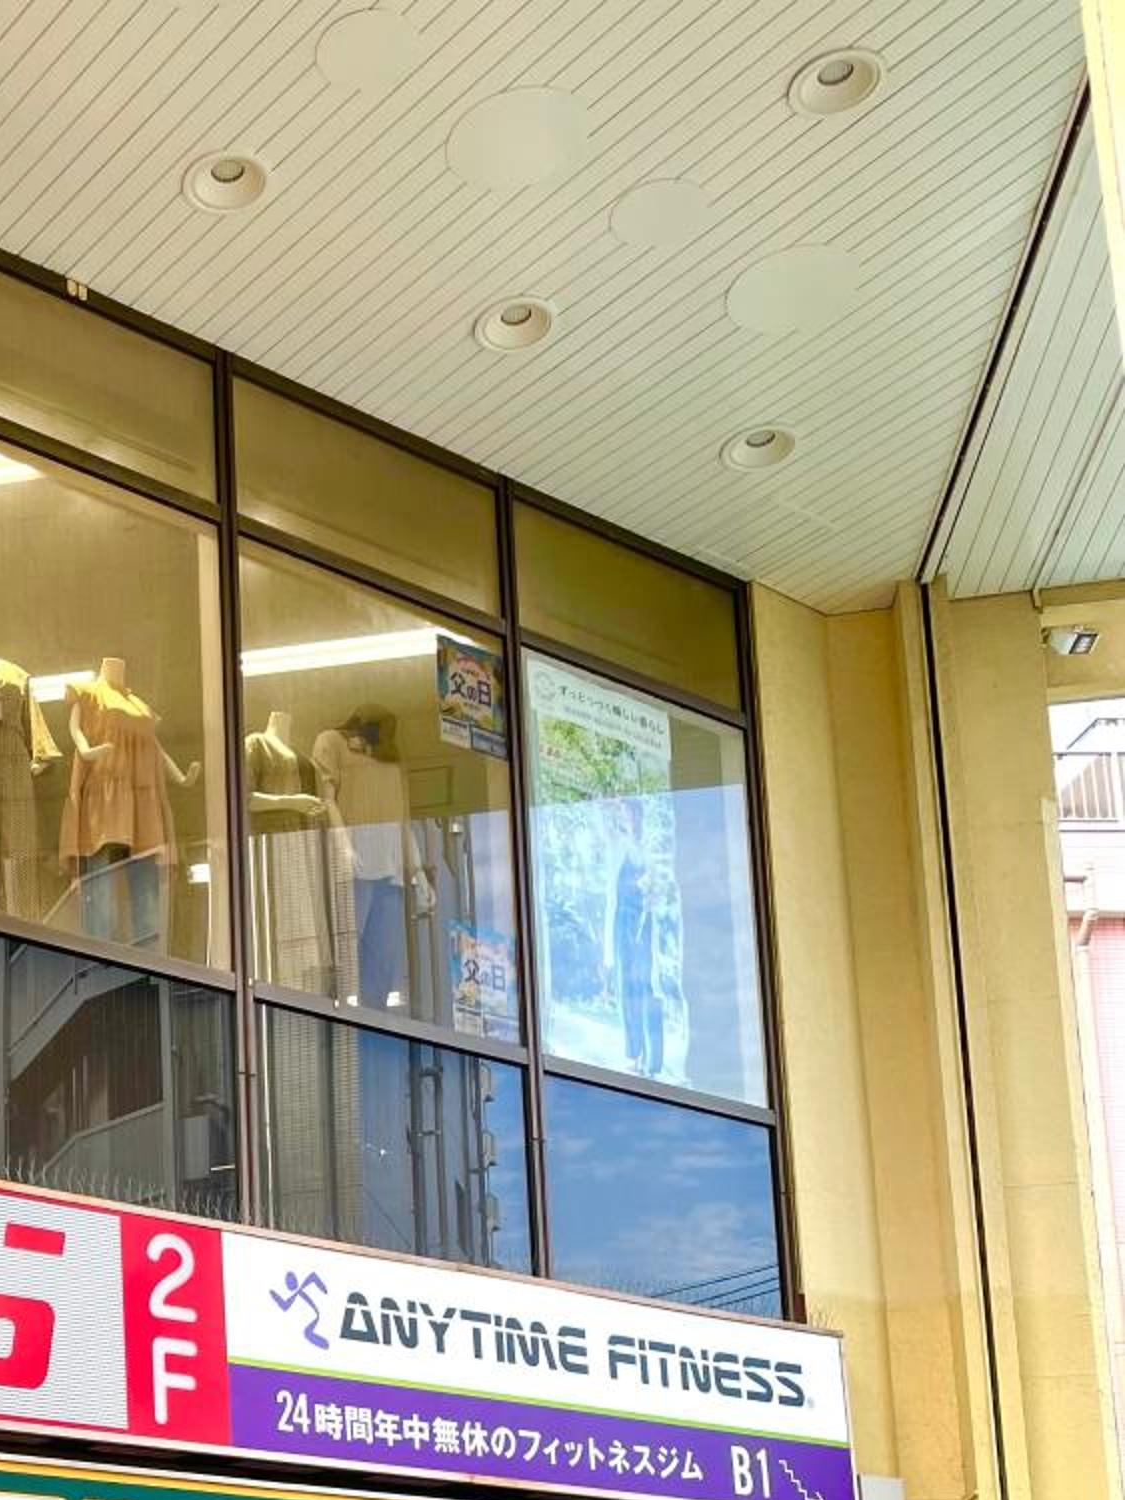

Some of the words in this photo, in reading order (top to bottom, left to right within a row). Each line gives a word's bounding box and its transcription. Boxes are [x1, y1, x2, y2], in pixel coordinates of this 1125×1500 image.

[450, 671, 493, 706] 父の日
[463, 958, 506, 993] 父の日
[145, 1233, 198, 1425] 2F
[339, 1290, 590, 1376] ANYTIME
[607, 1334, 806, 1408] FITNESS
[275, 1389, 704, 1482] 24時間年中無休のフィットネスジム
[731, 1445, 773, 1500] B1
